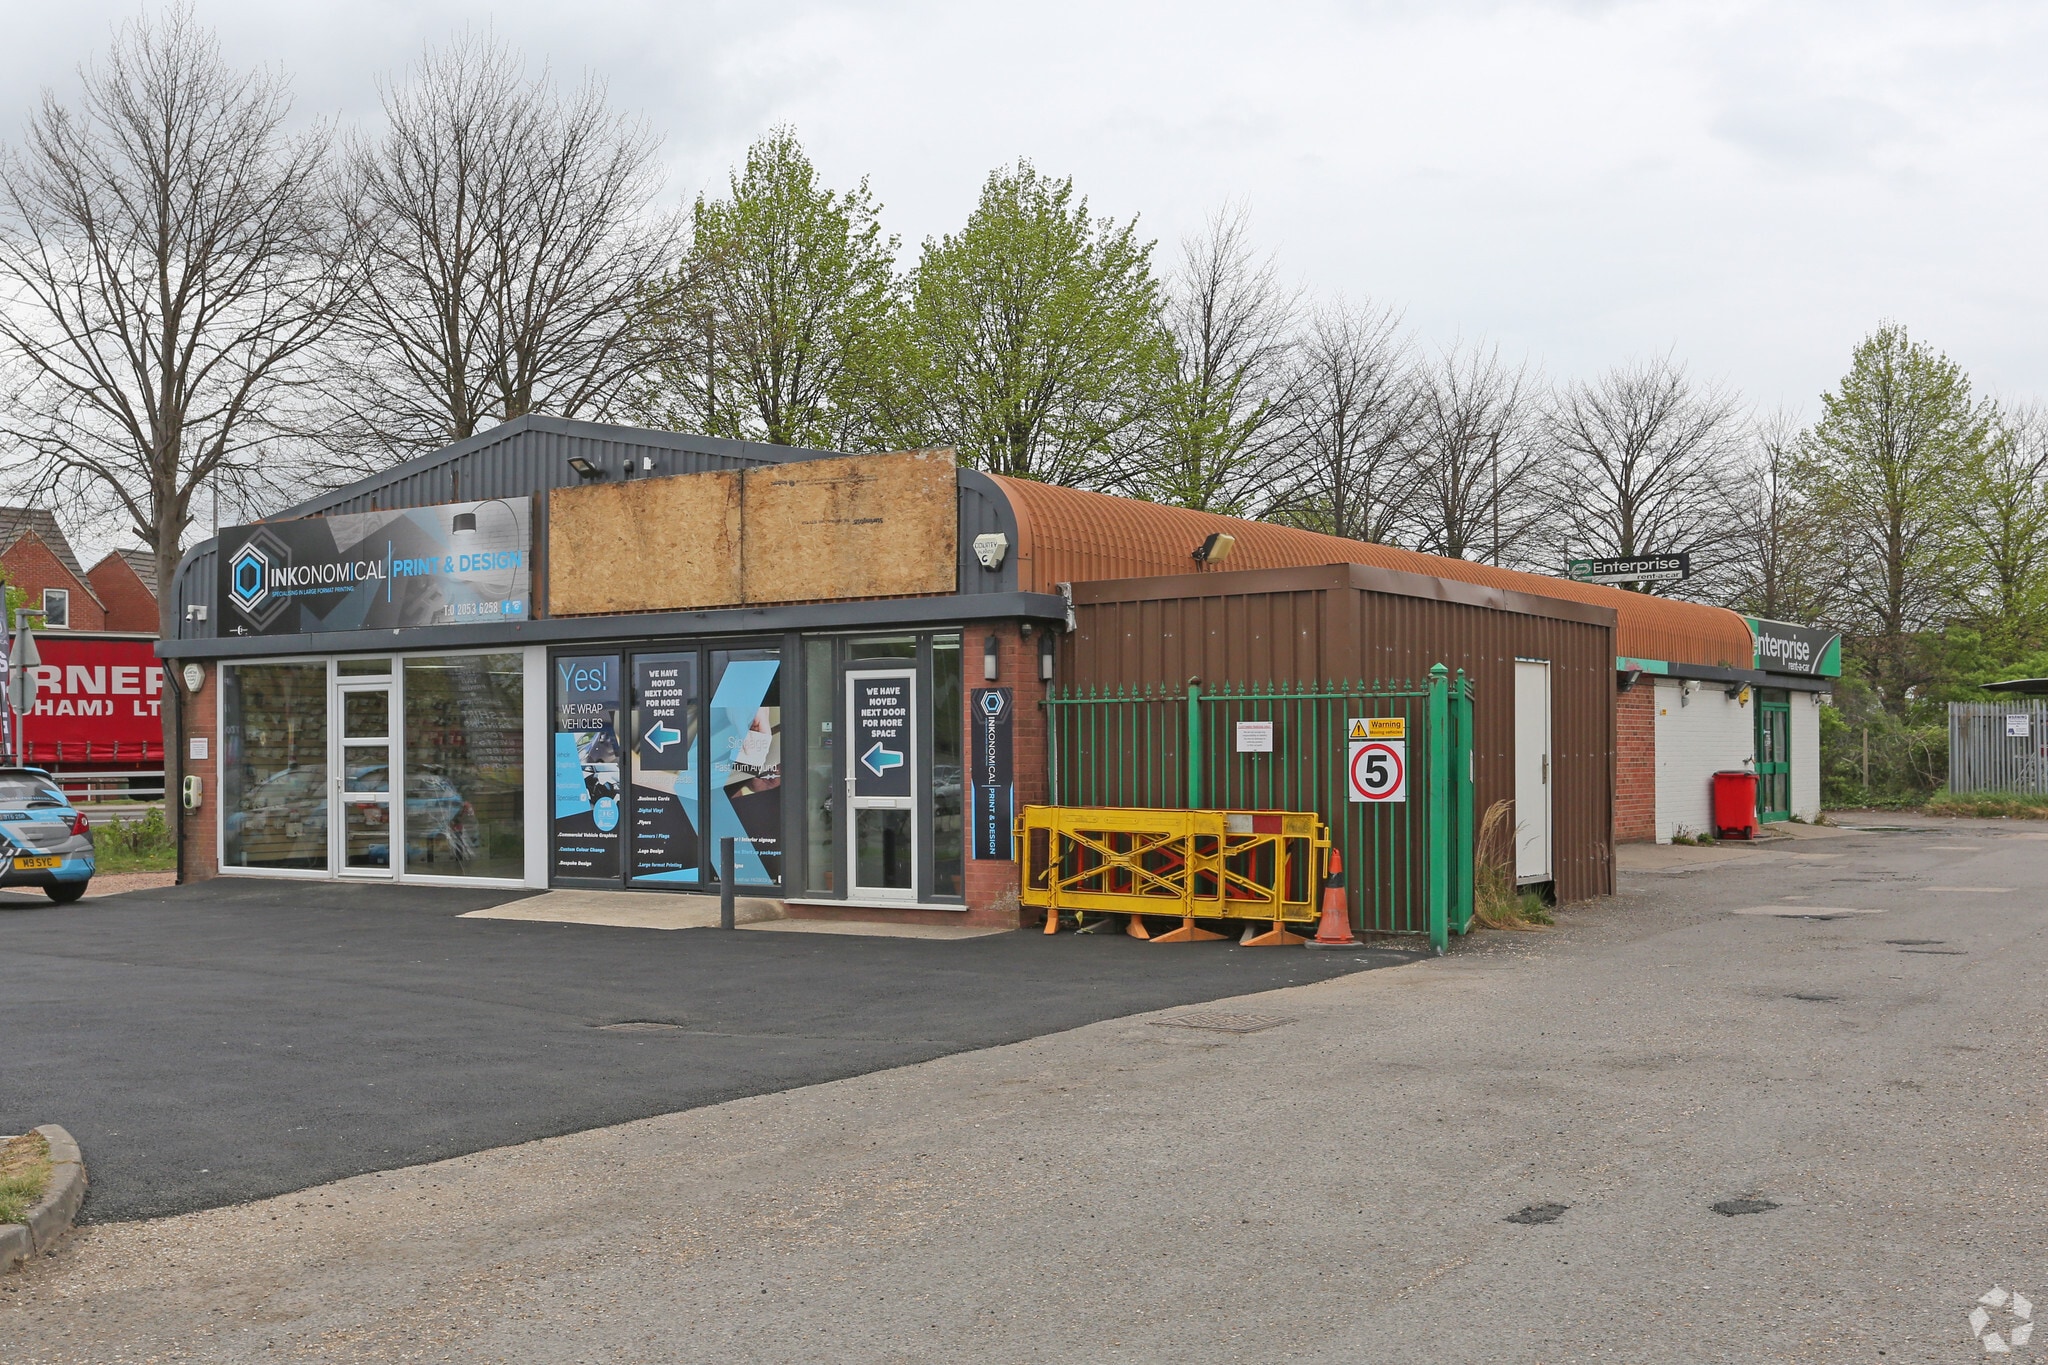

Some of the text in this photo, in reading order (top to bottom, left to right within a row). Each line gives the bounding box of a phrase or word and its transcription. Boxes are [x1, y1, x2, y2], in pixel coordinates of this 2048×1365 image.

[270, 550, 522, 587] INKONOMICAL PRINT & DESIGN
[1593, 558, 1680, 574] Enterprise
[1637, 572, 1680, 580] rent-a-car
[558, 661, 606, 692] Yes!
[644, 690, 662, 698] NEXT
[866, 687, 900, 696] WE HAVE
[869, 698, 898, 706] MOVED
[562, 703, 603, 714] WE WRAP
[861, 708, 906, 716] NEXT DOOR
[562, 718, 603, 728] VEHICLES
[880, 718, 902, 726] MORE
[871, 730, 896, 738] SPACE
[732, 763, 749, 772] Turn
[1365, 755, 1388, 788] 5
